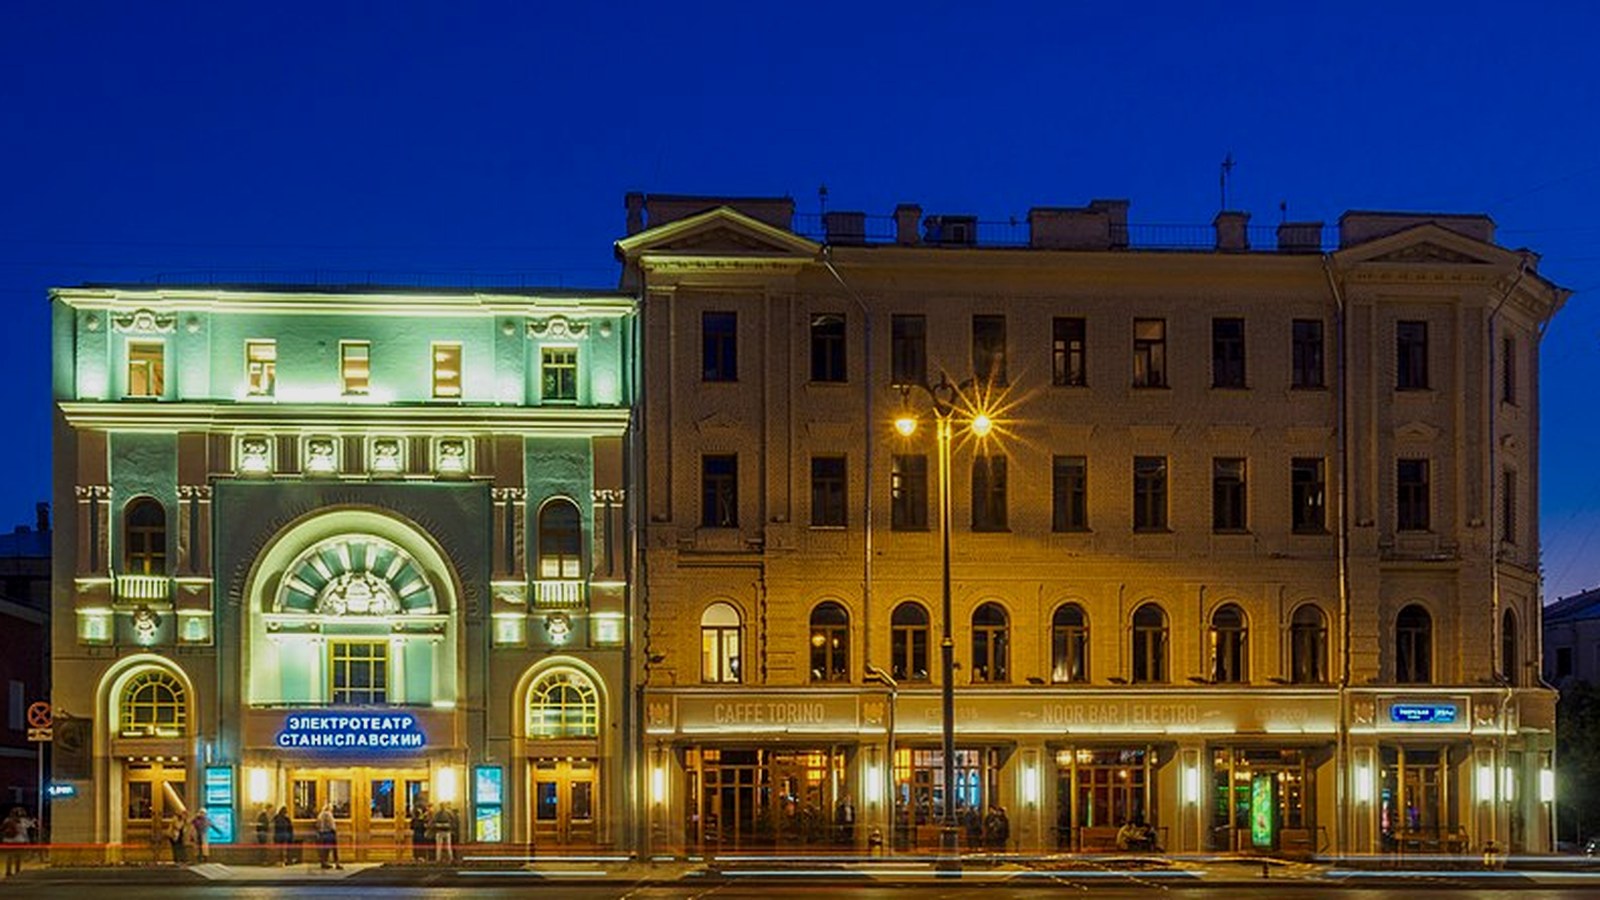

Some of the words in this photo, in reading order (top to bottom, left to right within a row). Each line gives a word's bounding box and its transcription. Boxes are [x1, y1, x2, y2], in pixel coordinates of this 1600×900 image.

[289, 717, 412, 730] ЭЛЕКТРОТЕАТР
[714, 703, 763, 724] CAFFE
[767, 703, 824, 724] TORINO
[1042, 704, 1084, 724] NOOR
[1089, 704, 1118, 723] BAR
[1133, 704, 1198, 724] ELECTRO
